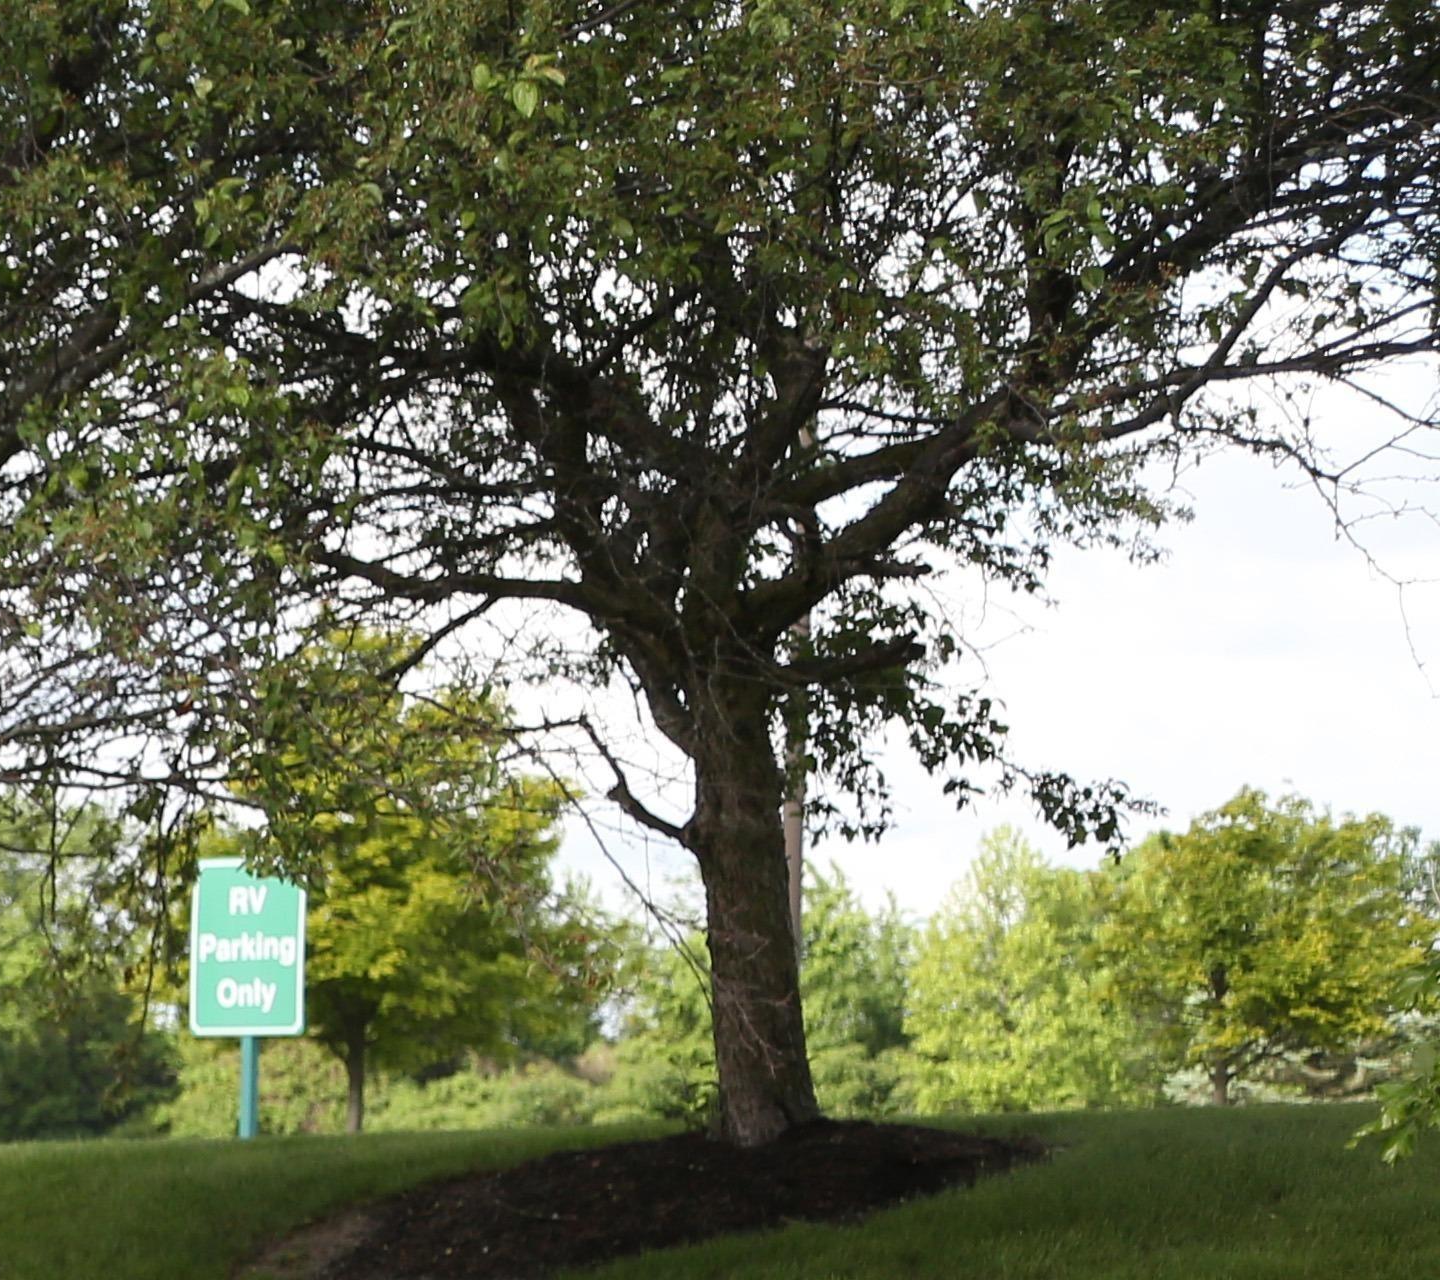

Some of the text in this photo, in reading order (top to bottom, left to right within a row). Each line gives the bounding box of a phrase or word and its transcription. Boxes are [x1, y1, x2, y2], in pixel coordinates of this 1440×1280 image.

[229, 885, 268, 916] RV
[198, 931, 297, 967] Parking
[215, 977, 277, 1014] Only
